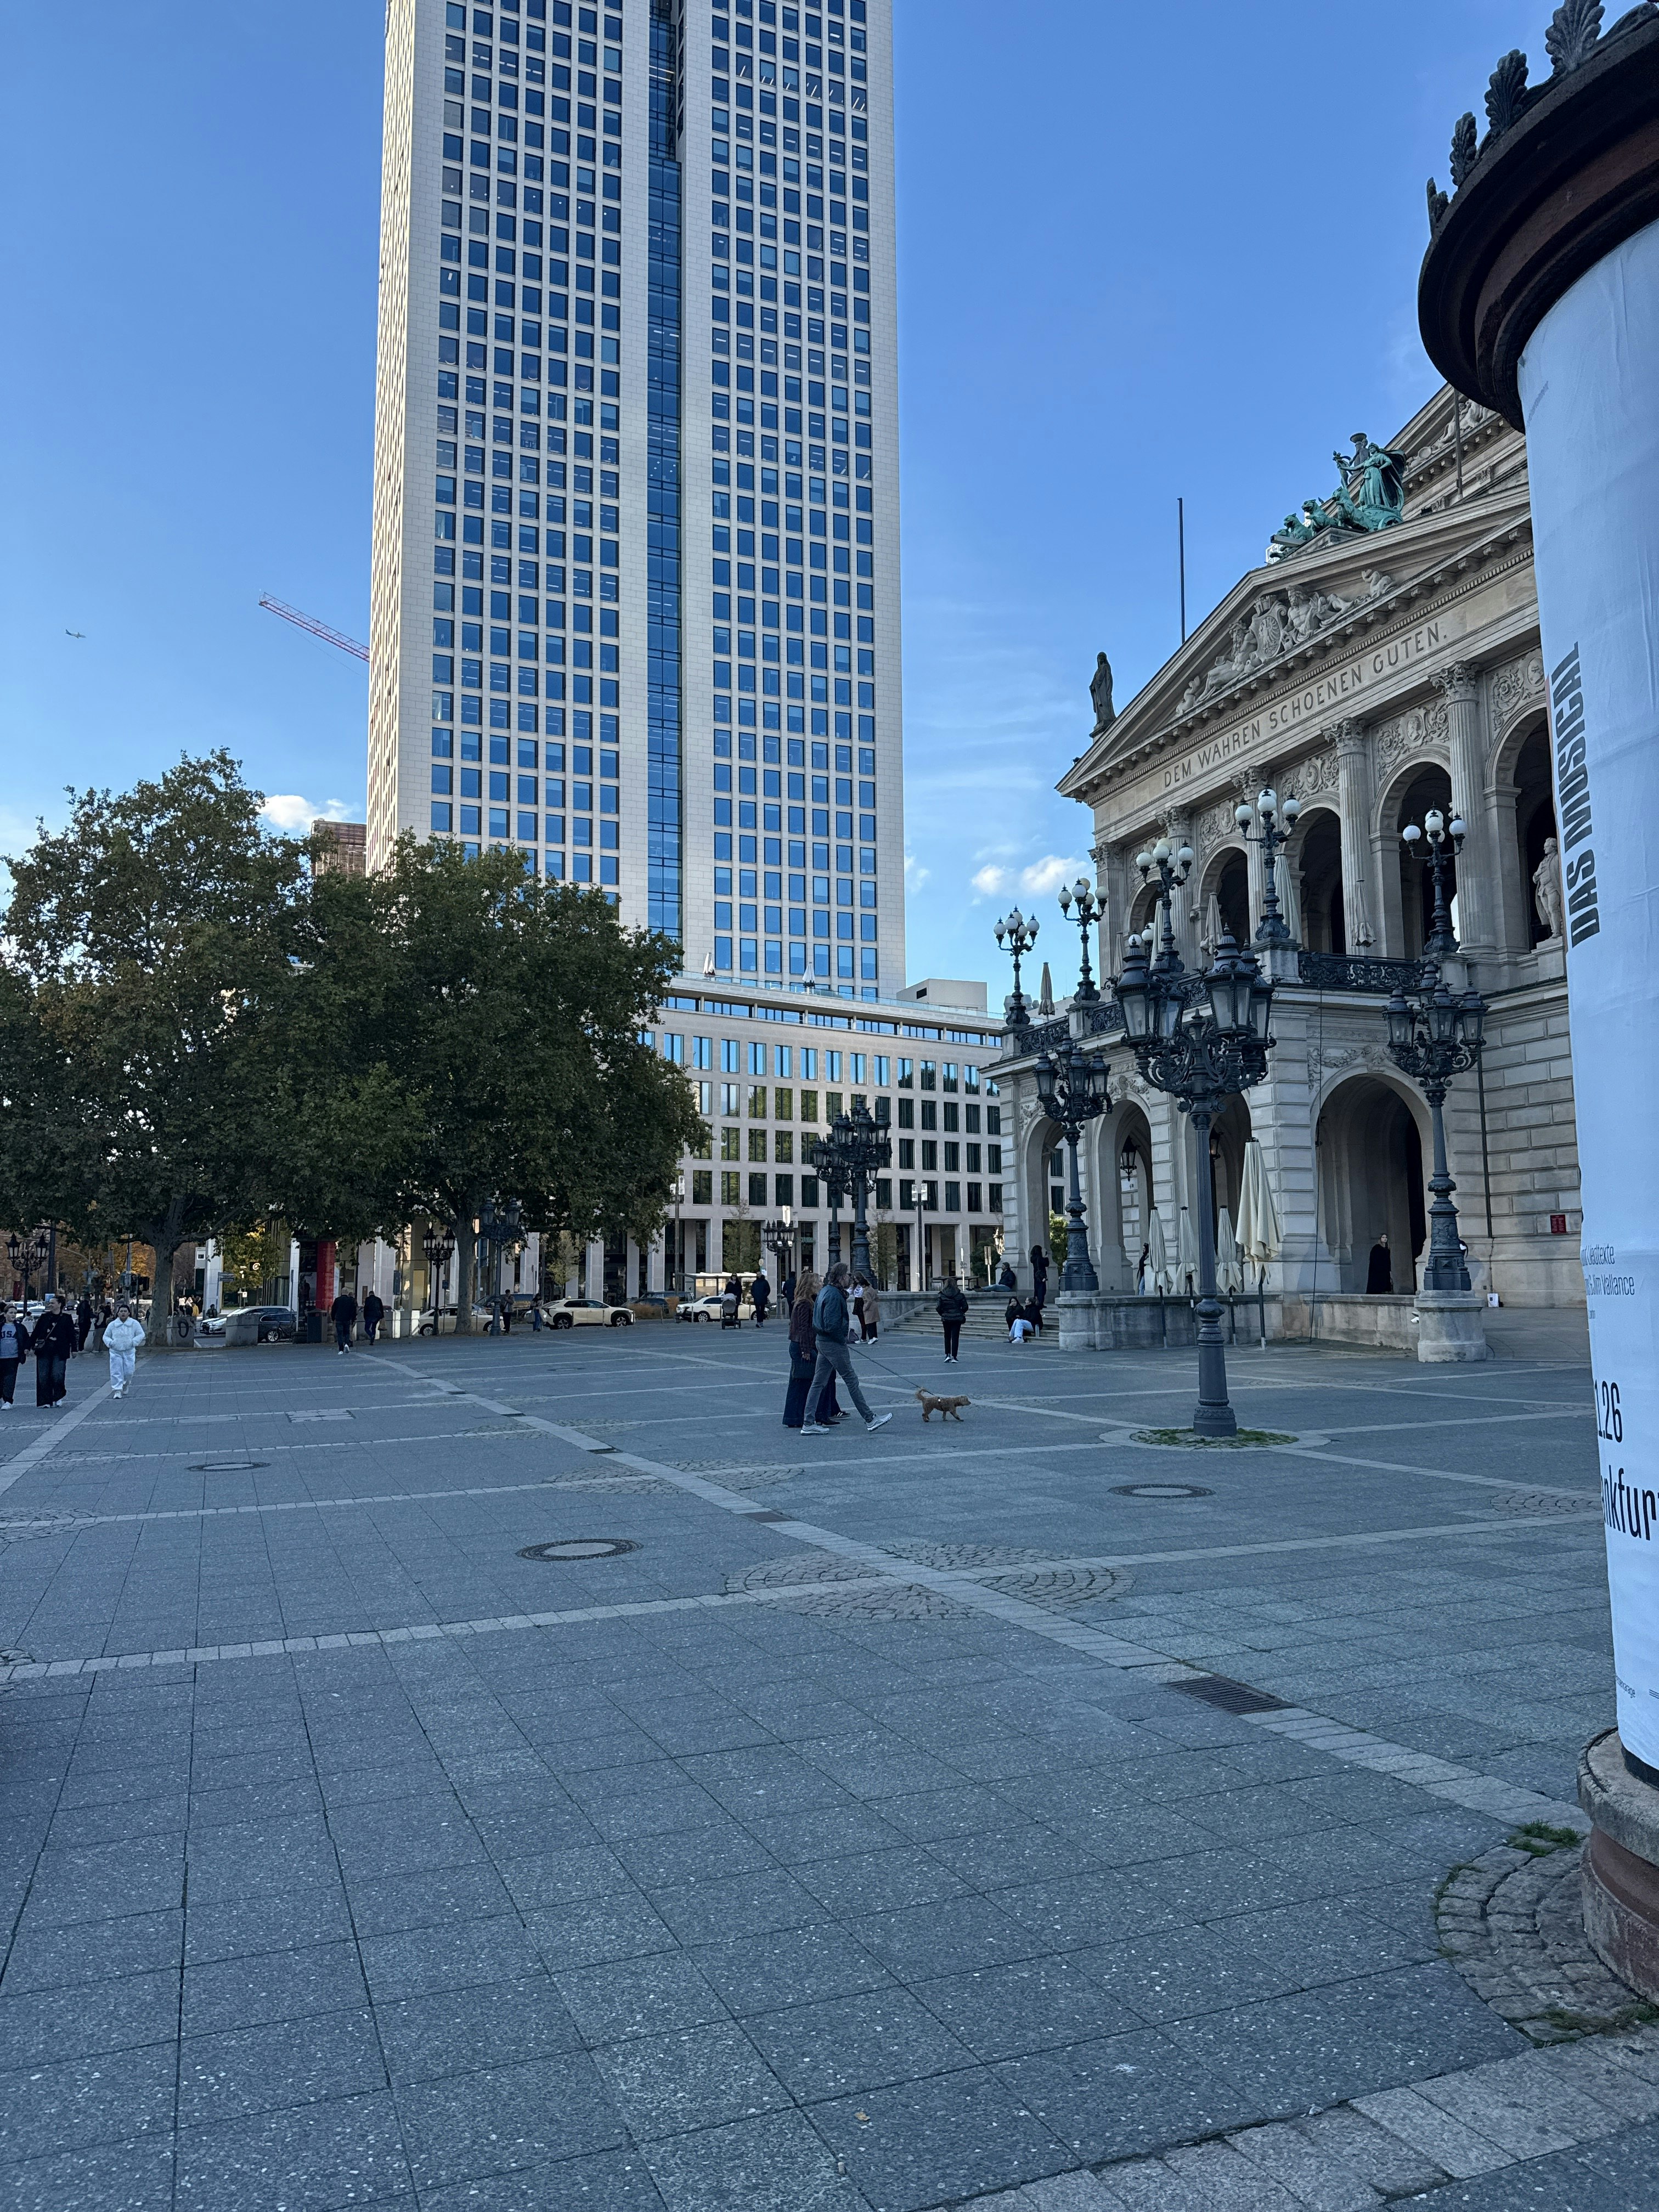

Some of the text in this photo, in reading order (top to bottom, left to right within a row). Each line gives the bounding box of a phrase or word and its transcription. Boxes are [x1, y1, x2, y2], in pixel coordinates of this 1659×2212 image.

[1164, 622, 1447, 788] DEM WAHREN SCHOENEN GUTEN.
[1551, 641, 1600, 948] DAS MUSICAL
[1588, 1243, 1615, 1265] Liedtexte
[1601, 1274, 1635, 1295] Vallance
[1601, 1465, 1659, 1541] nkfur
